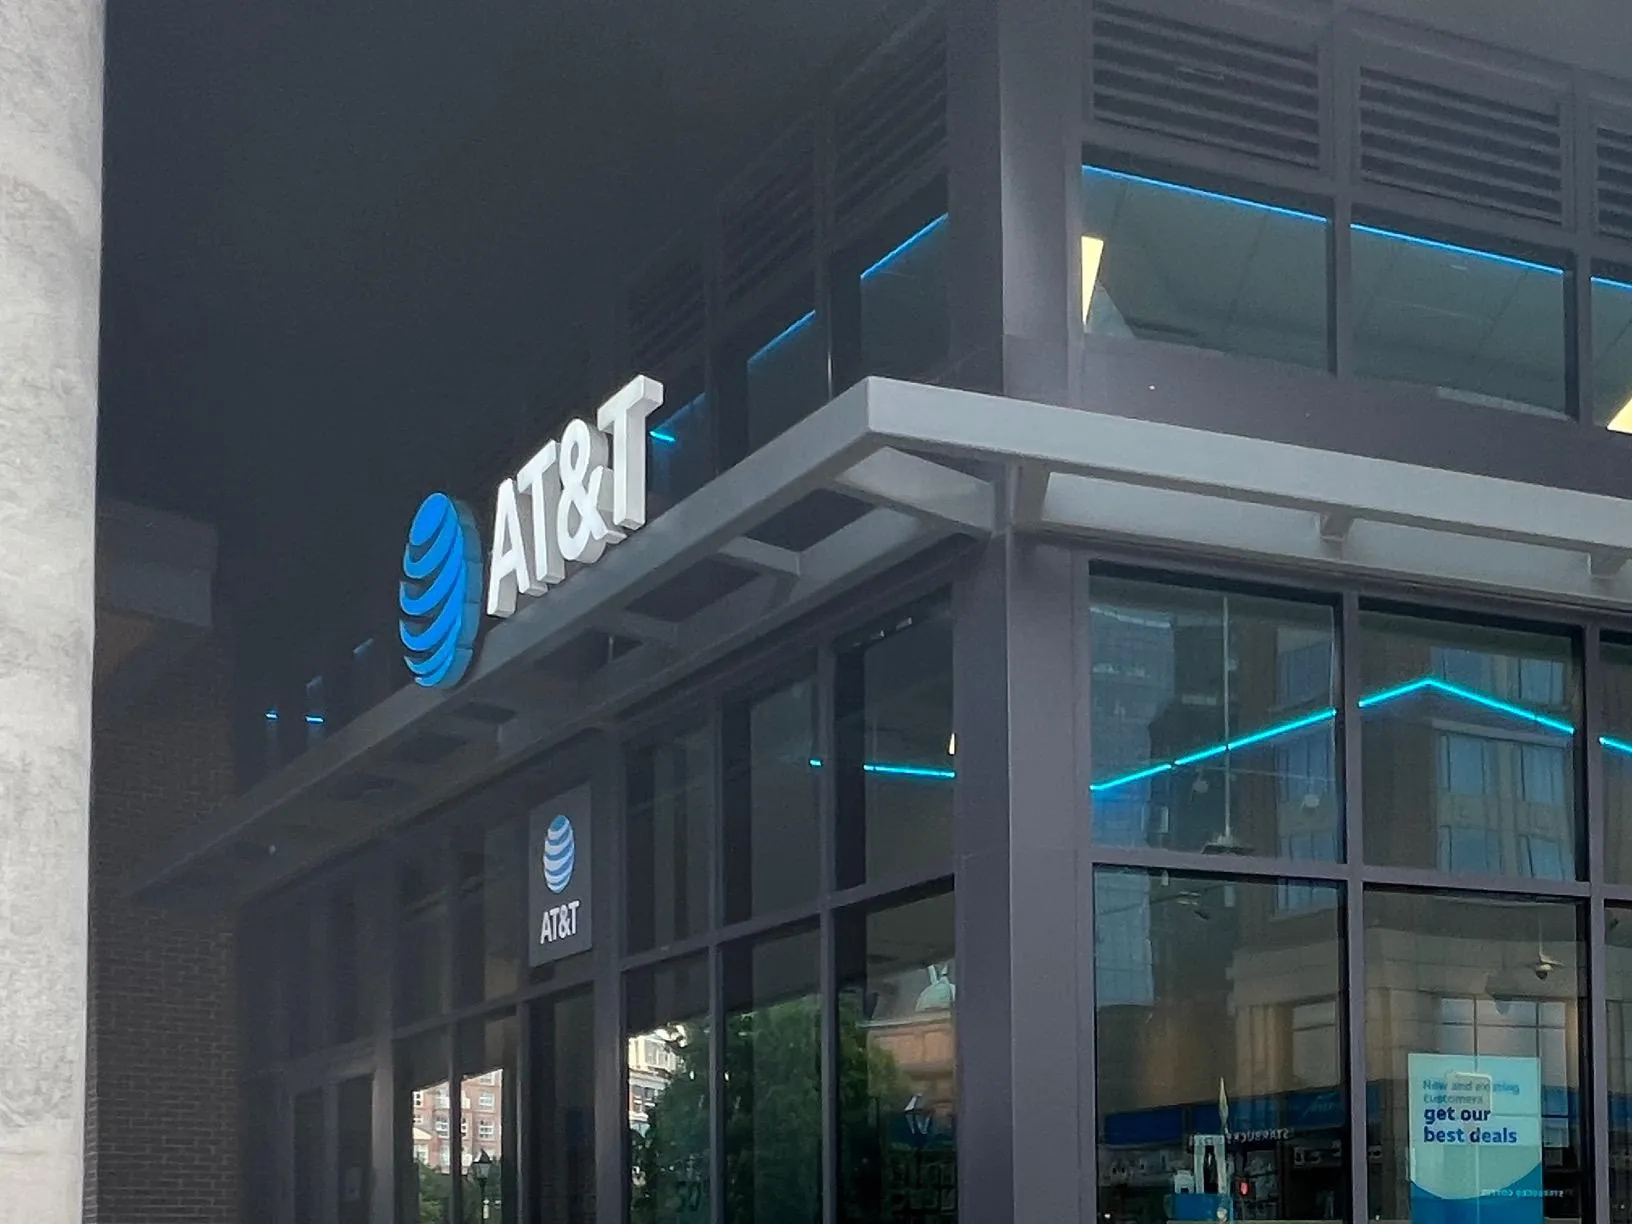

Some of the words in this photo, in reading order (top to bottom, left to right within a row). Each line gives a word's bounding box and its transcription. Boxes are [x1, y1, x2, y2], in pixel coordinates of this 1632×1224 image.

[487, 374, 663, 618] AT&T
[540, 901, 580, 944] AT&T
[1424, 1107, 1456, 1124] get
[1461, 1109, 1491, 1121] our
[1424, 1126, 1465, 1143] best
[1470, 1127, 1518, 1143] deals
